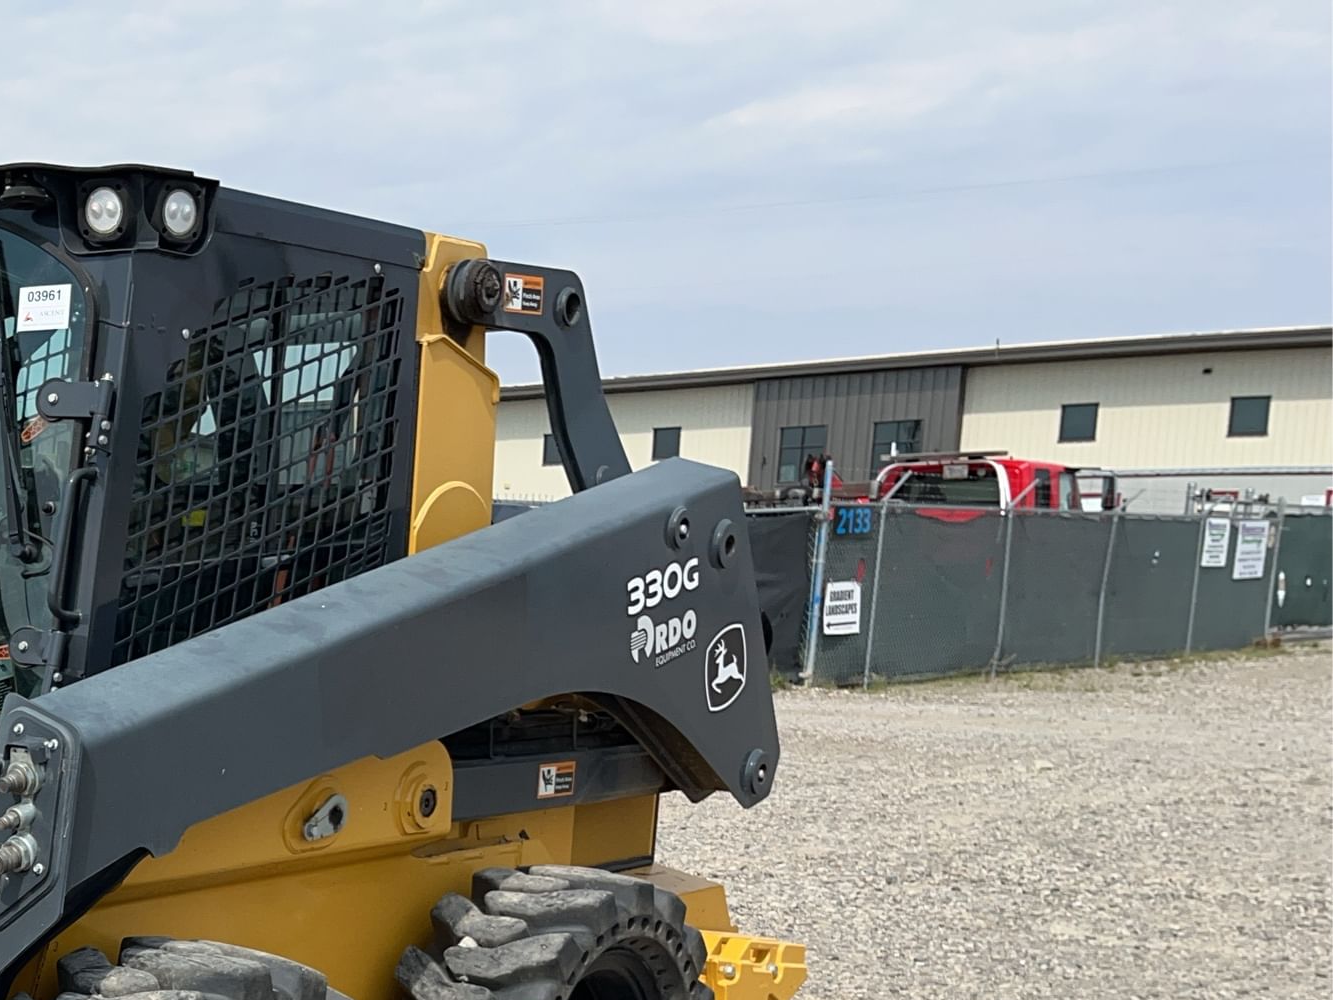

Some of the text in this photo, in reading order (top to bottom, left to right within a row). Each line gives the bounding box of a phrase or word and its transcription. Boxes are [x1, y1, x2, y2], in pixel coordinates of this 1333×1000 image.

[27, 289, 61, 302] 03961
[836, 508, 872, 535] 2133
[627, 557, 699, 616] 330G
[655, 609, 697, 654] RDO
